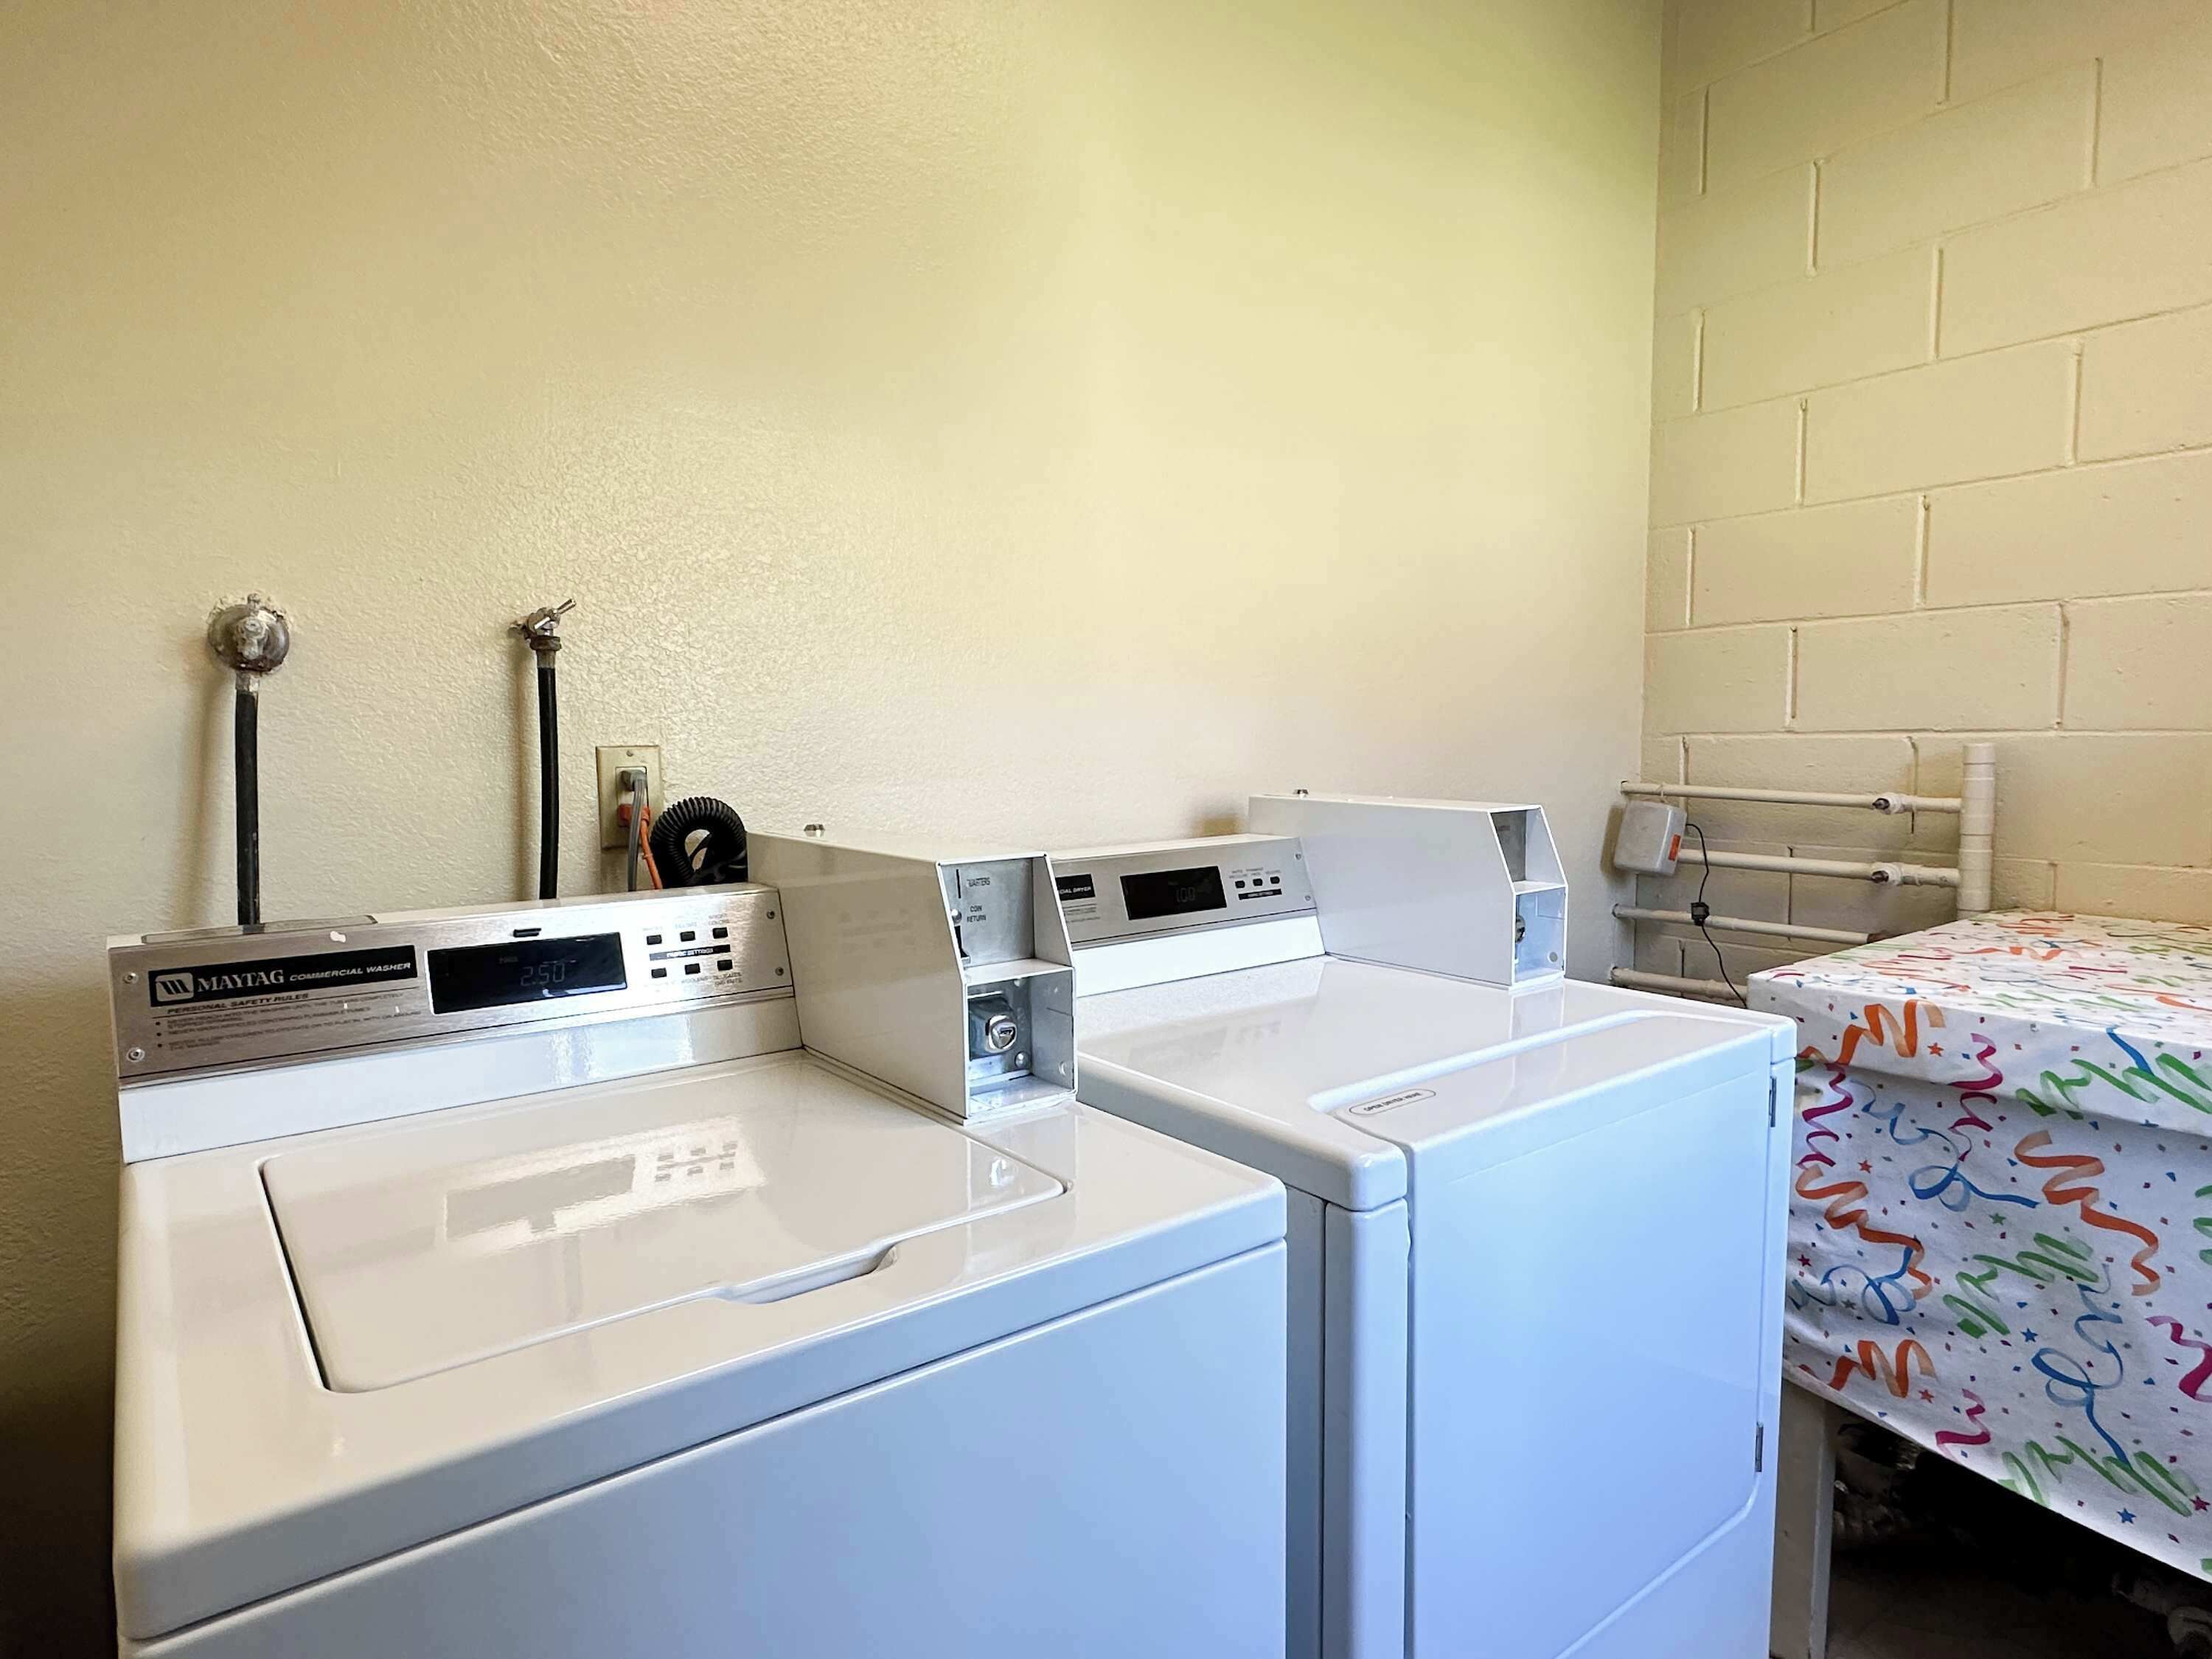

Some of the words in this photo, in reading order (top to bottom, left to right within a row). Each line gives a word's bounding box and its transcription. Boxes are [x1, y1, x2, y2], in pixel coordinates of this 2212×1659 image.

[967, 914, 987, 922] RETURN
[197, 970, 285, 992] MAYTAG
[289, 967, 364, 981] COMMERCIAL
[366, 962, 411, 973] WASHER
[520, 962, 566, 987] 2.50
[167, 1003, 227, 1015] PERSONAL
[230, 997, 272, 1007] SAFETY
[274, 992, 309, 1002] RULES
